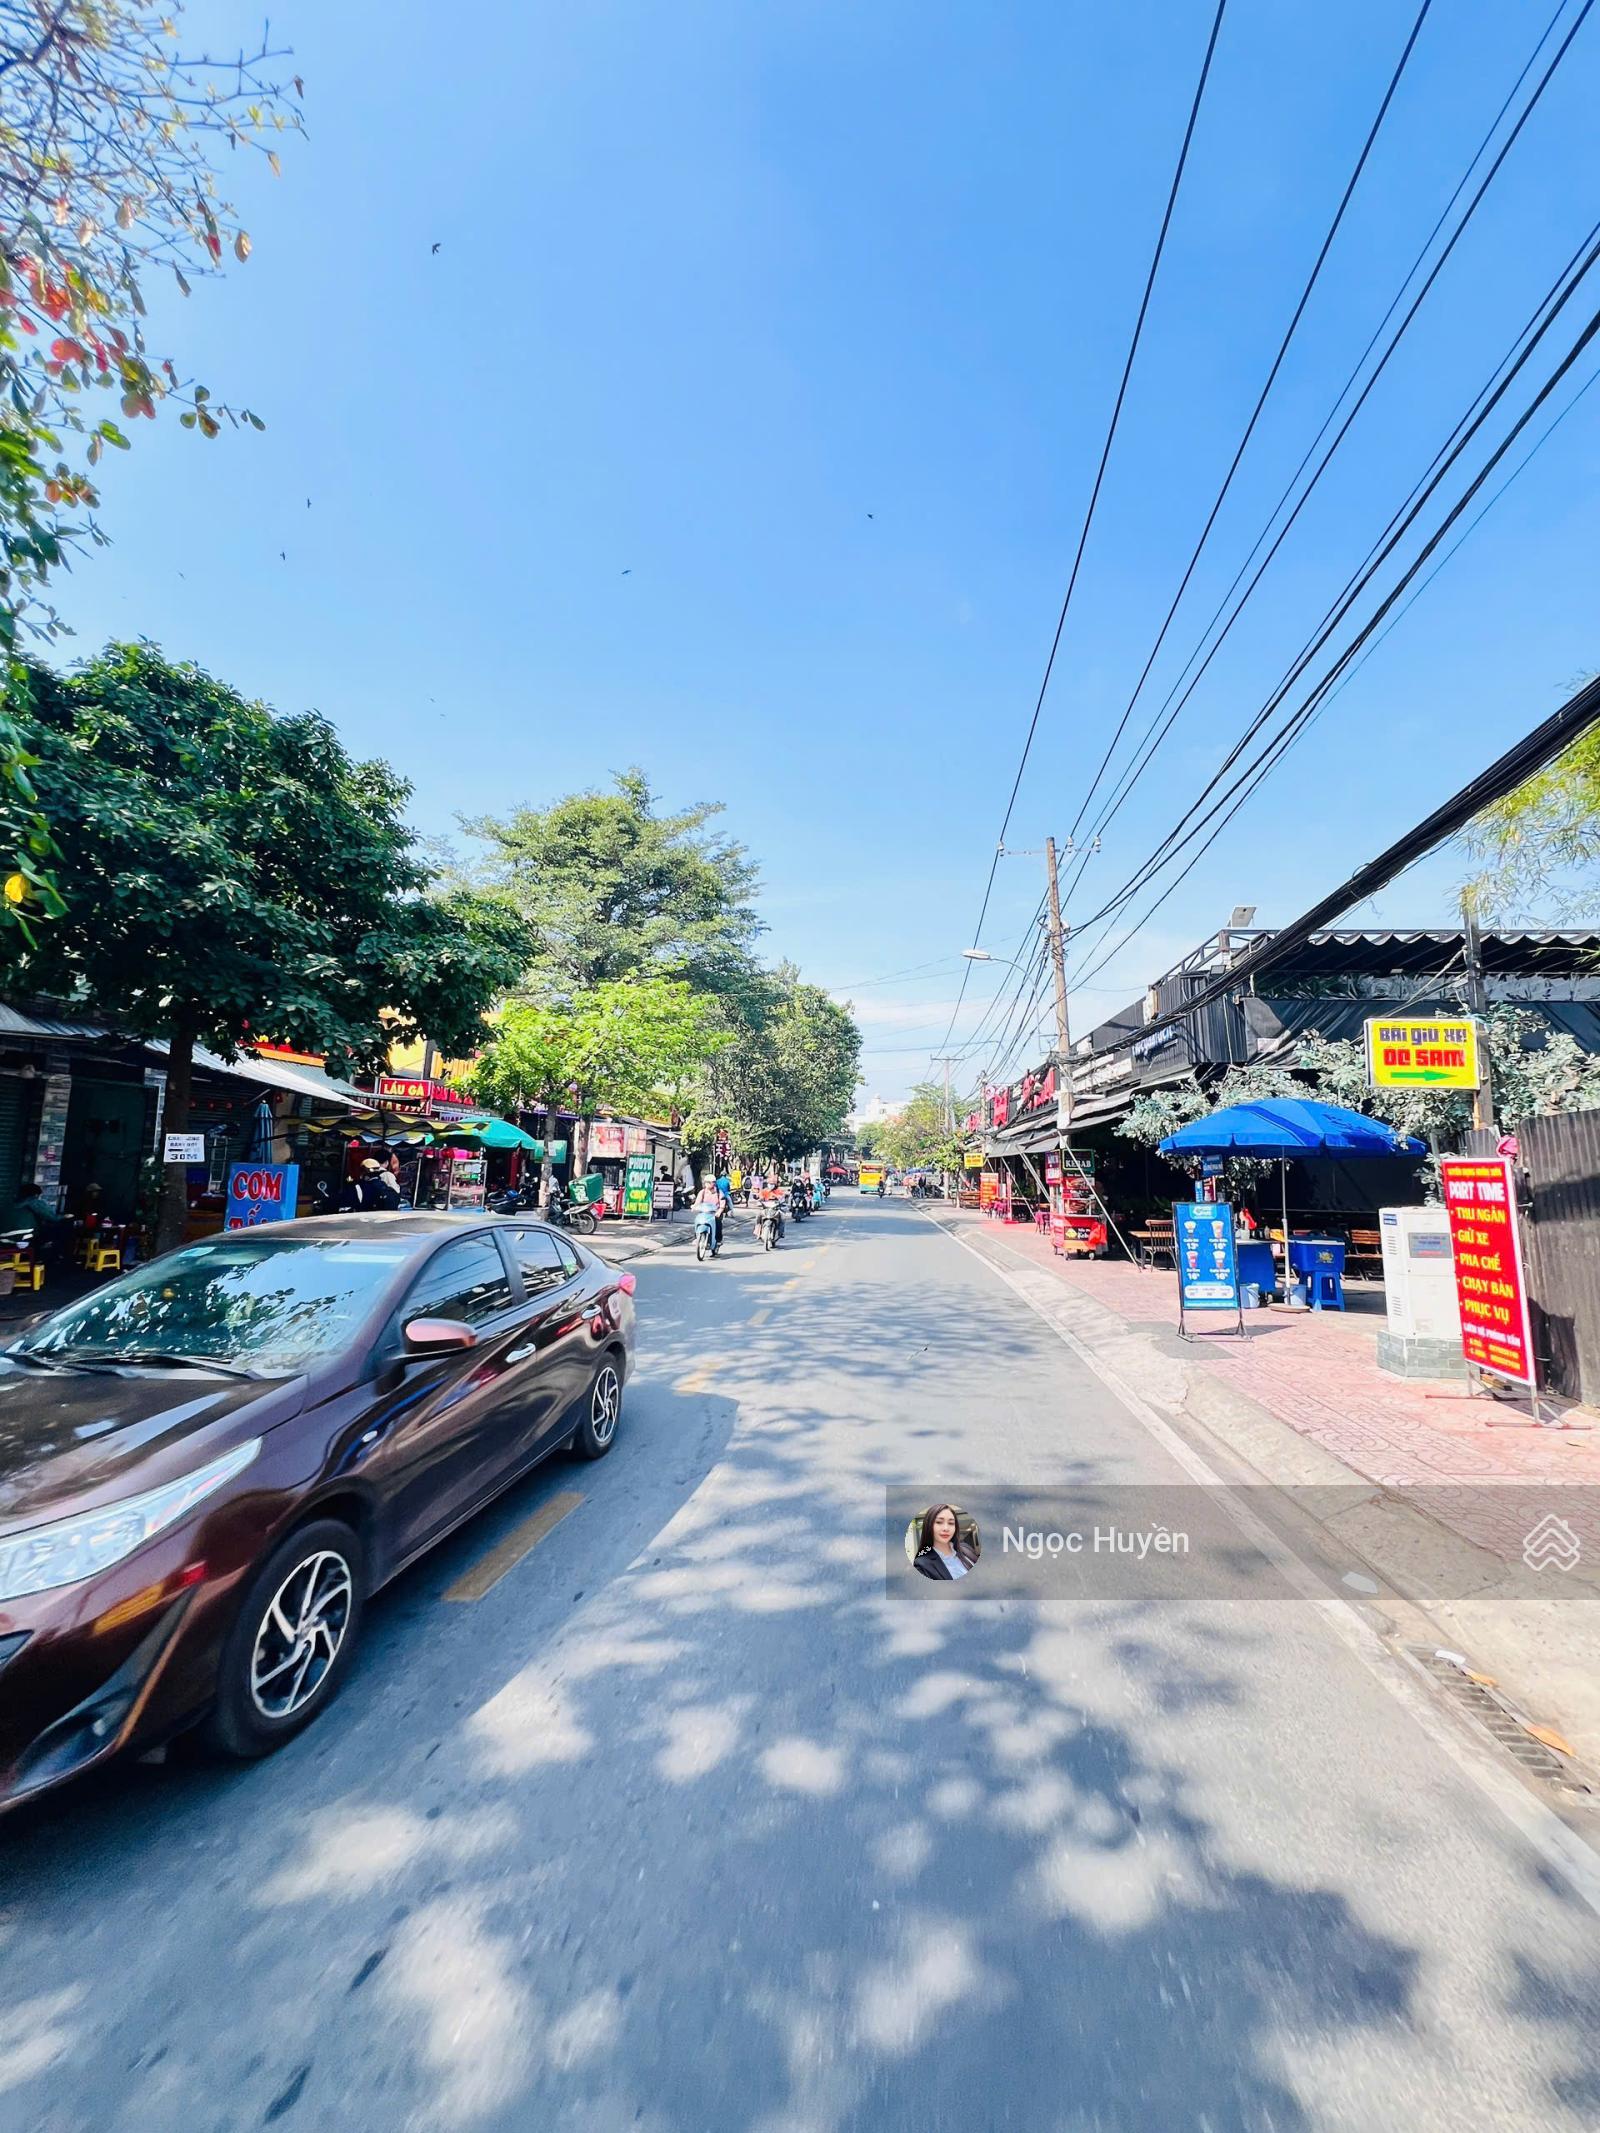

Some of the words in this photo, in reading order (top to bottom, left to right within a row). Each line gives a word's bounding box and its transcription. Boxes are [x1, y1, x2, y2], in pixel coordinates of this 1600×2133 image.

[232, 1168, 283, 1201] CƠM
[1448, 1181, 1474, 1200] PART
[1476, 1181, 1505, 1202] TIME
[1455, 1206, 1475, 1220] THU
[1475, 1231, 1490, 1245] XE
